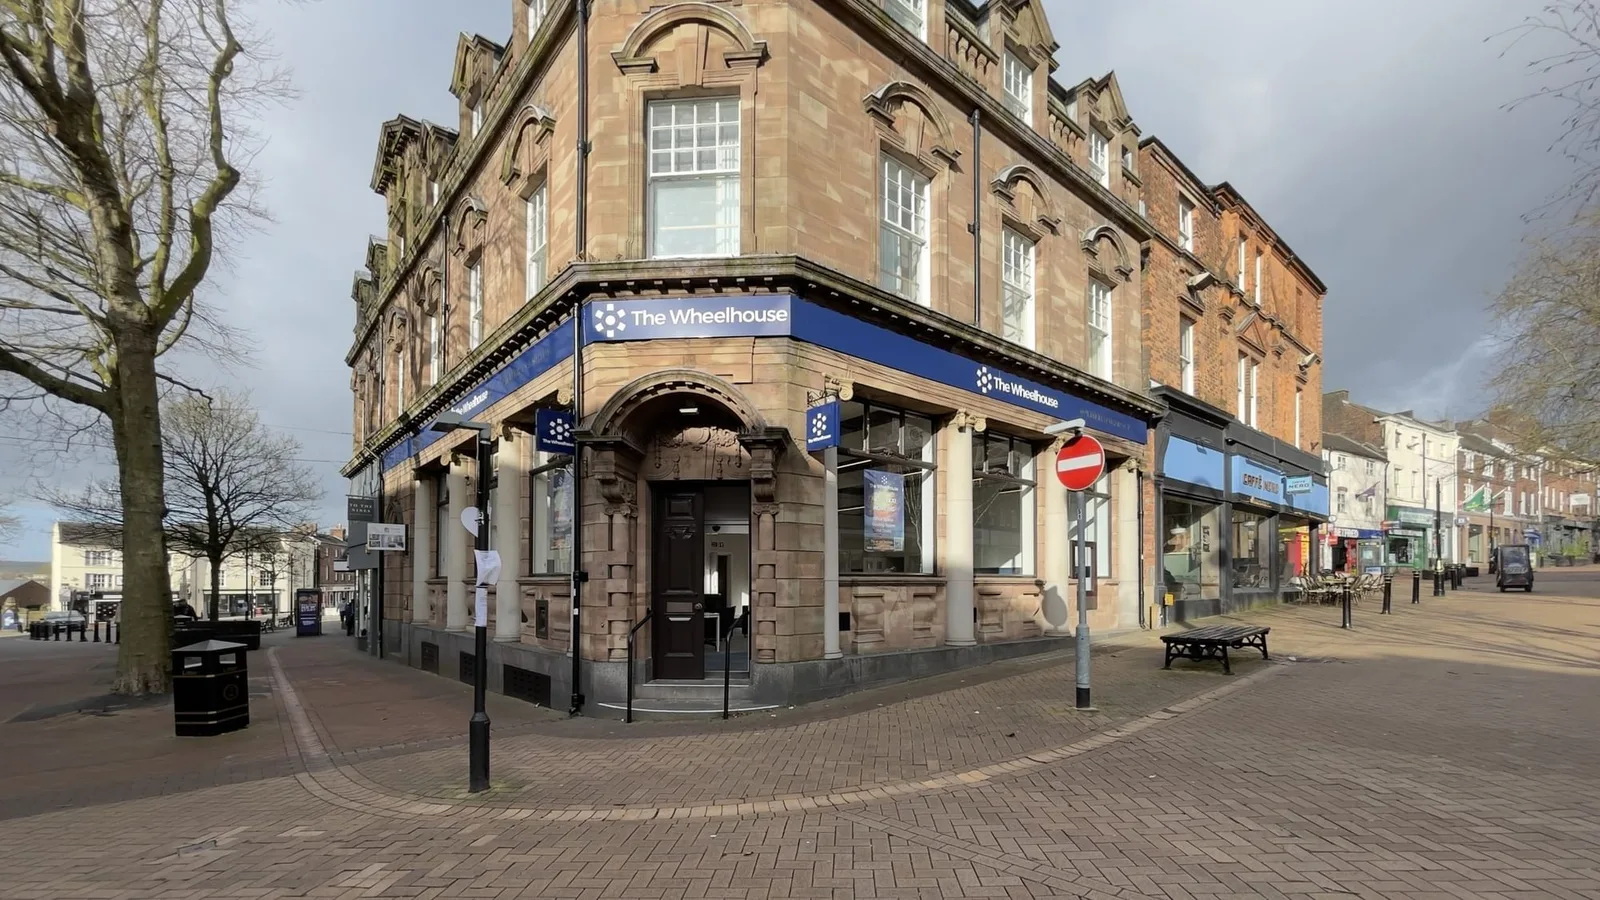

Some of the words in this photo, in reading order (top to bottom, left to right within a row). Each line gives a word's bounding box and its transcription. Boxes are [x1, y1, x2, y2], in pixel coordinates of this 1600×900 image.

[631, 310, 666, 326] The
[670, 307, 788, 325] Wheelhouse
[993, 376, 1010, 392] The
[1011, 382, 1058, 407] Wheelhouse
